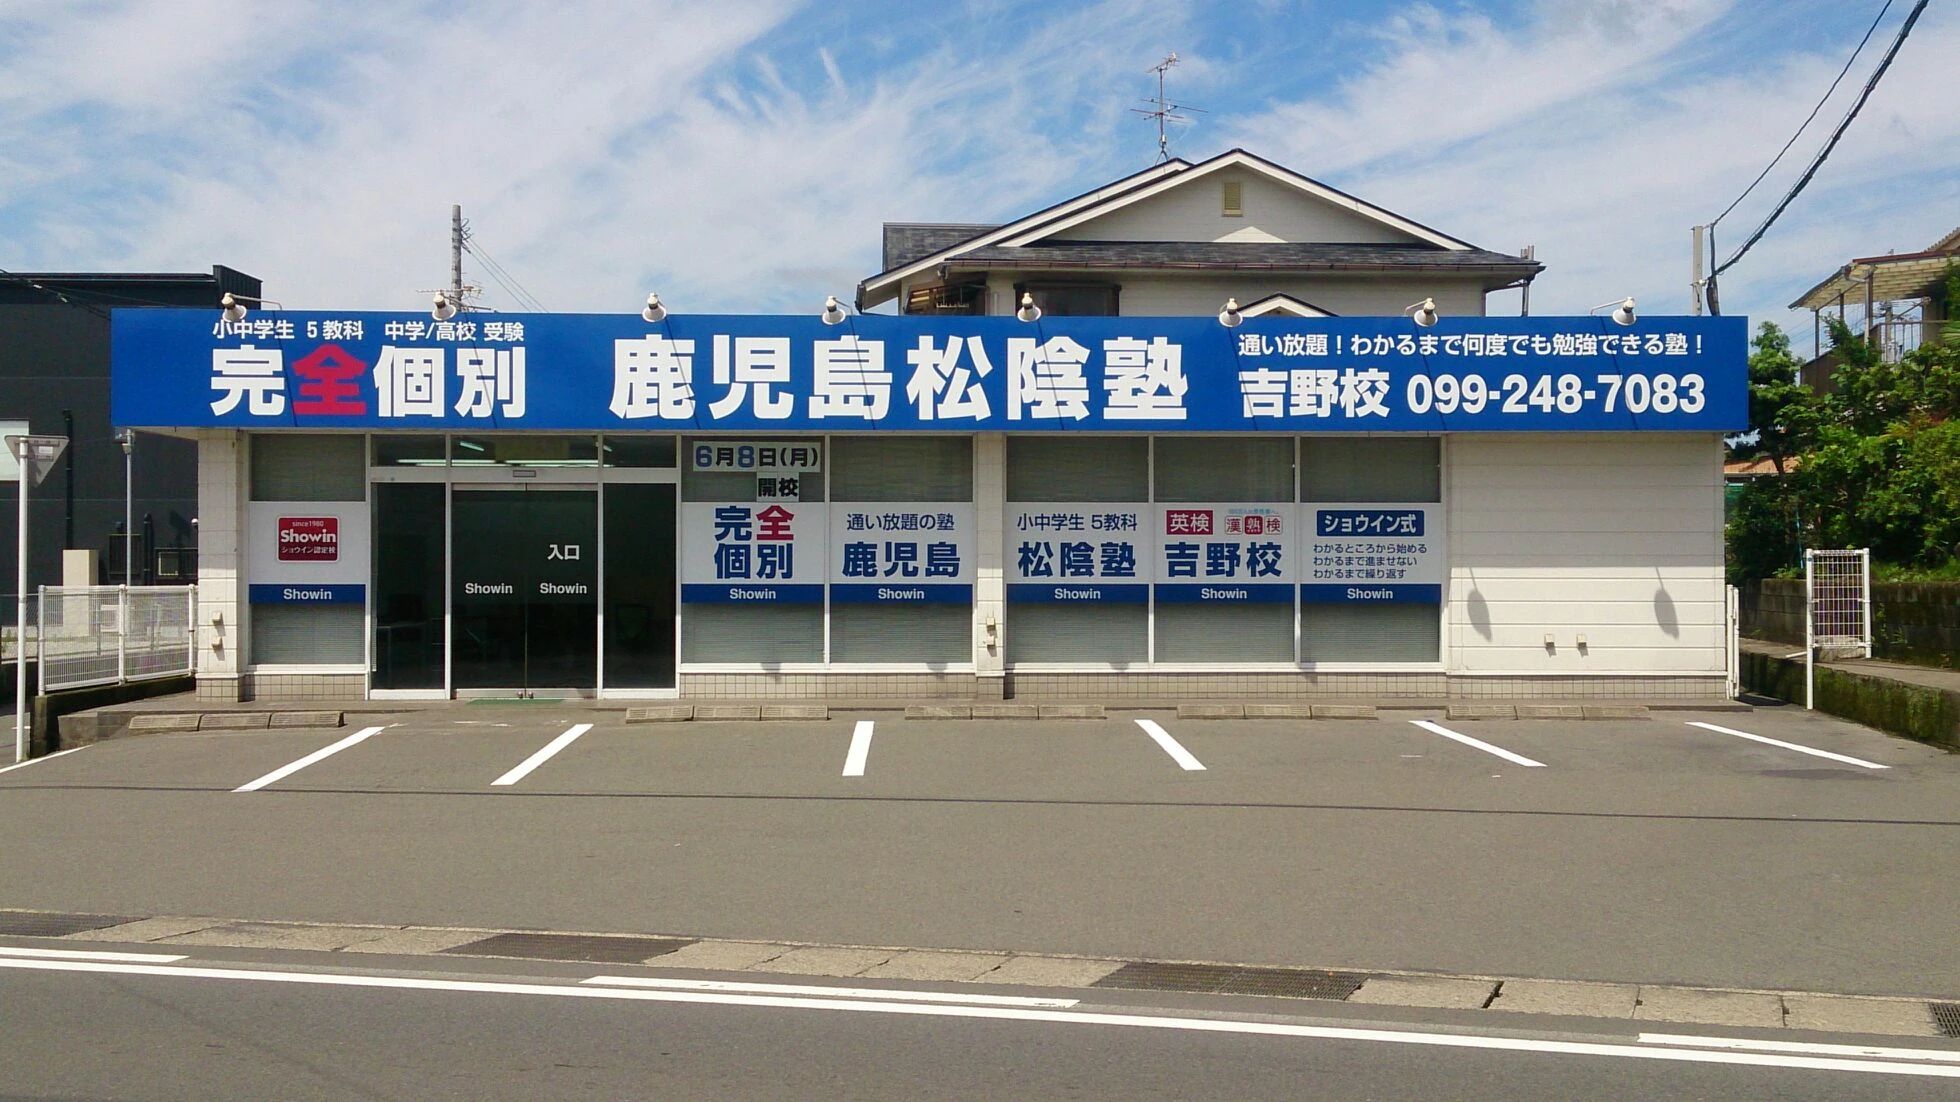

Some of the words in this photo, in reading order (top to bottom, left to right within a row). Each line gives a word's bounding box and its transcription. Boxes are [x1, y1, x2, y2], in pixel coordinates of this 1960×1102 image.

[212, 319, 295, 341] 小中学生
[385, 320, 476, 342] 中学/高校
[484, 321, 525, 343] 受験
[210, 344, 526, 418] 完全個別
[609, 334, 1188, 422] 鹿児島松陰塾
[1238, 368, 1390, 419] 吉野校
[1406, 373, 1706, 415] 099-248-7083
[695, 445, 819, 469] 6月8日(月)
[758, 478, 799, 497] 開校
[714, 505, 795, 542] 完全
[846, 513, 955, 531] 通い放題の塾
[1017, 513, 1085, 531] 小中学生
[1091, 513, 1137, 531] 5教科
[1170, 513, 1210, 533] 英検
[1324, 513, 1417, 533] ショウイン式
[280, 528, 337, 543] Showin
[547, 544, 580, 560] 入口
[1313, 543, 1427, 554] わかるところから始める
[713, 543, 794, 579] 個別
[841, 541, 960, 577] 鹿児島
[1018, 541, 1136, 577] 松陰塾
[1164, 541, 1282, 577] 吉野校
[1313, 556, 1418, 567] わかるまで進ませない
[1313, 568, 1407, 579] わかるまで繰り返す
[283, 588, 332, 600] Showin
[464, 583, 513, 594] Showin
[539, 583, 588, 594] Showin
[729, 588, 777, 600] Showin
[877, 588, 925, 600] Showin
[1054, 588, 1101, 600] Showin
[1201, 588, 1247, 599] Showin
[1346, 588, 1393, 599] Showin
